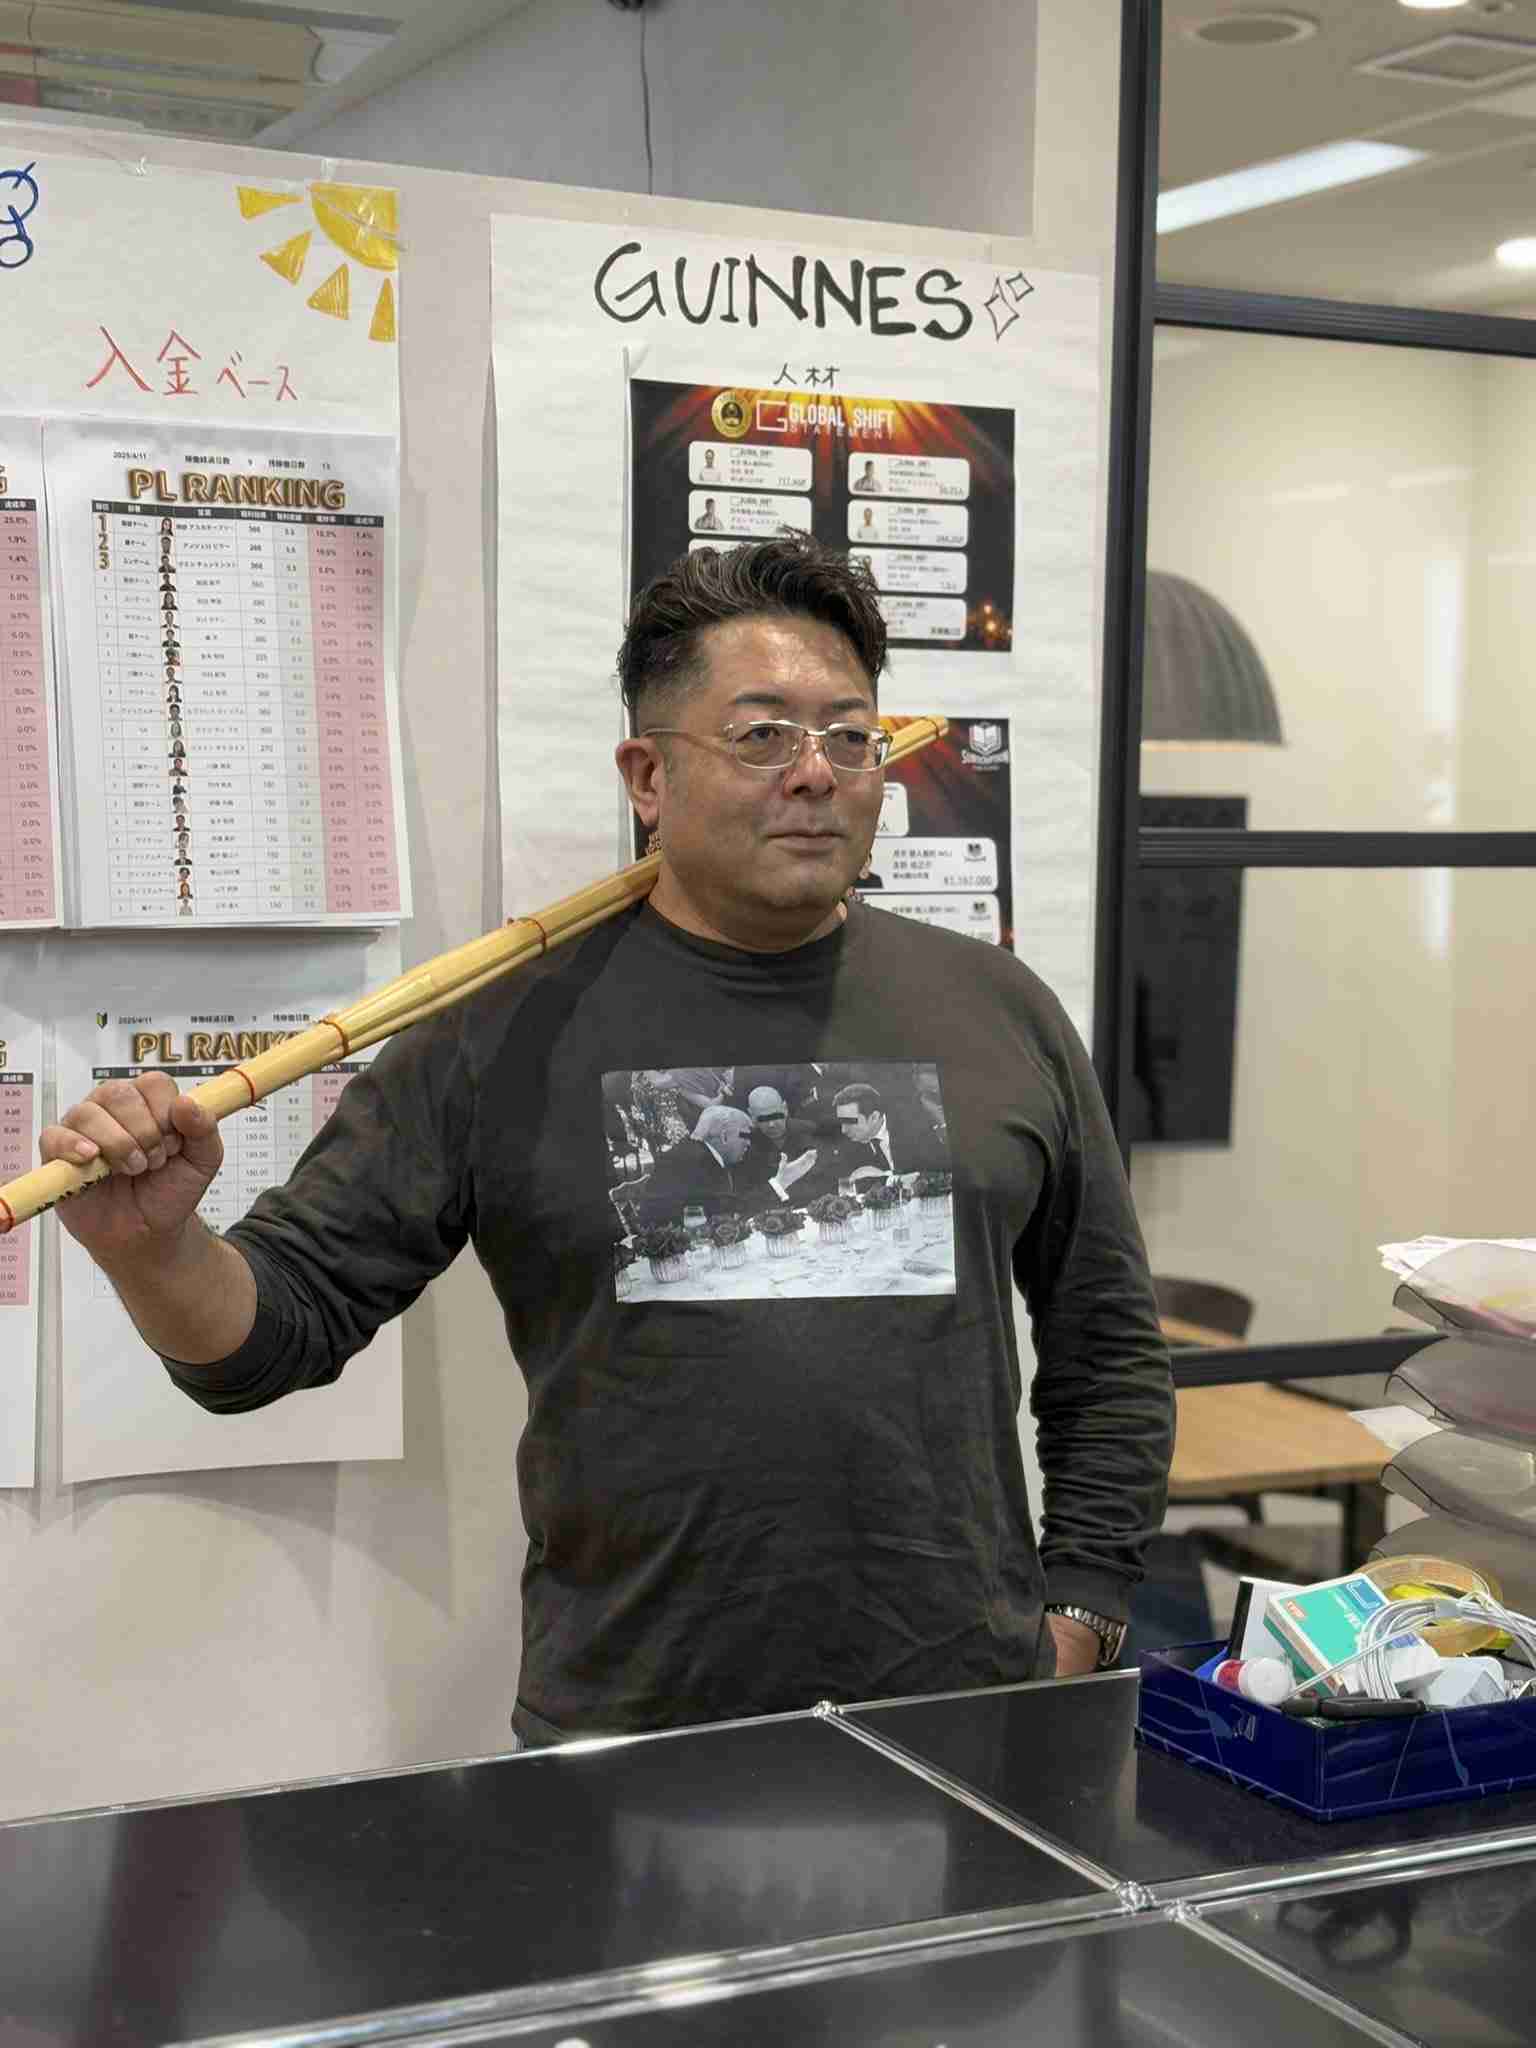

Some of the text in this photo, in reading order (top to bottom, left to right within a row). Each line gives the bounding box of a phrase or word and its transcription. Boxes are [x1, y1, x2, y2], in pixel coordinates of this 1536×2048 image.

[594, 241, 974, 340] GUINNES
[86, 325, 299, 401] 入金ベース
[773, 363, 840, 388] 人材
[788, 402, 846, 427] GLOBAL
[853, 407, 896, 429] SHIFT
[127, 468, 346, 509] PL RANKING
[132, 1031, 183, 1063] PL
